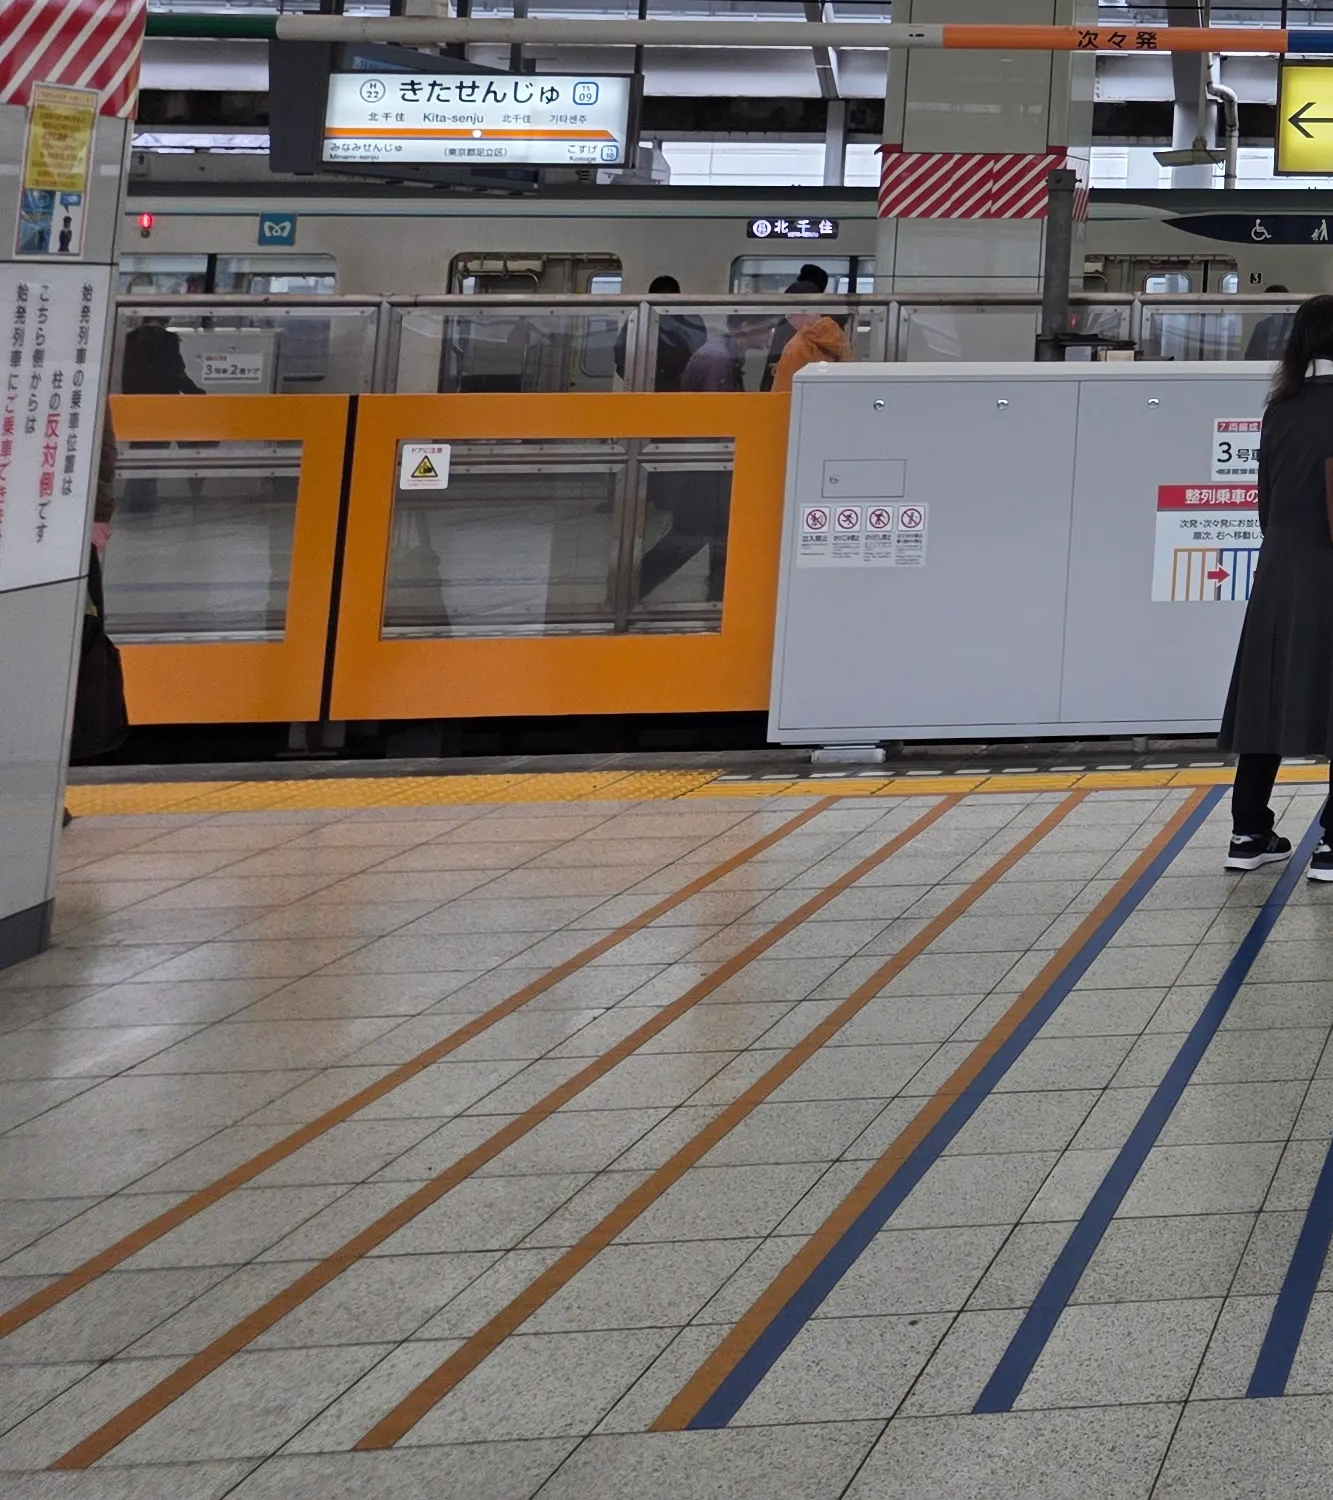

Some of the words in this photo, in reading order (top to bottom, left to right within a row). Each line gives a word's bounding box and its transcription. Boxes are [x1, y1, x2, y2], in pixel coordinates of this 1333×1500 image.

[1077, 30, 1158, 49] 次々発
[369, 82, 377, 90] H
[366, 91, 379, 99] 22
[399, 80, 560, 104] きたせんじゅ
[578, 93, 592, 102] 09
[423, 112, 484, 125] Kita-senju
[330, 142, 403, 153] みなみせんじゅ
[567, 145, 598, 154] こすげ
[1252, 273, 1259, 283] 3
